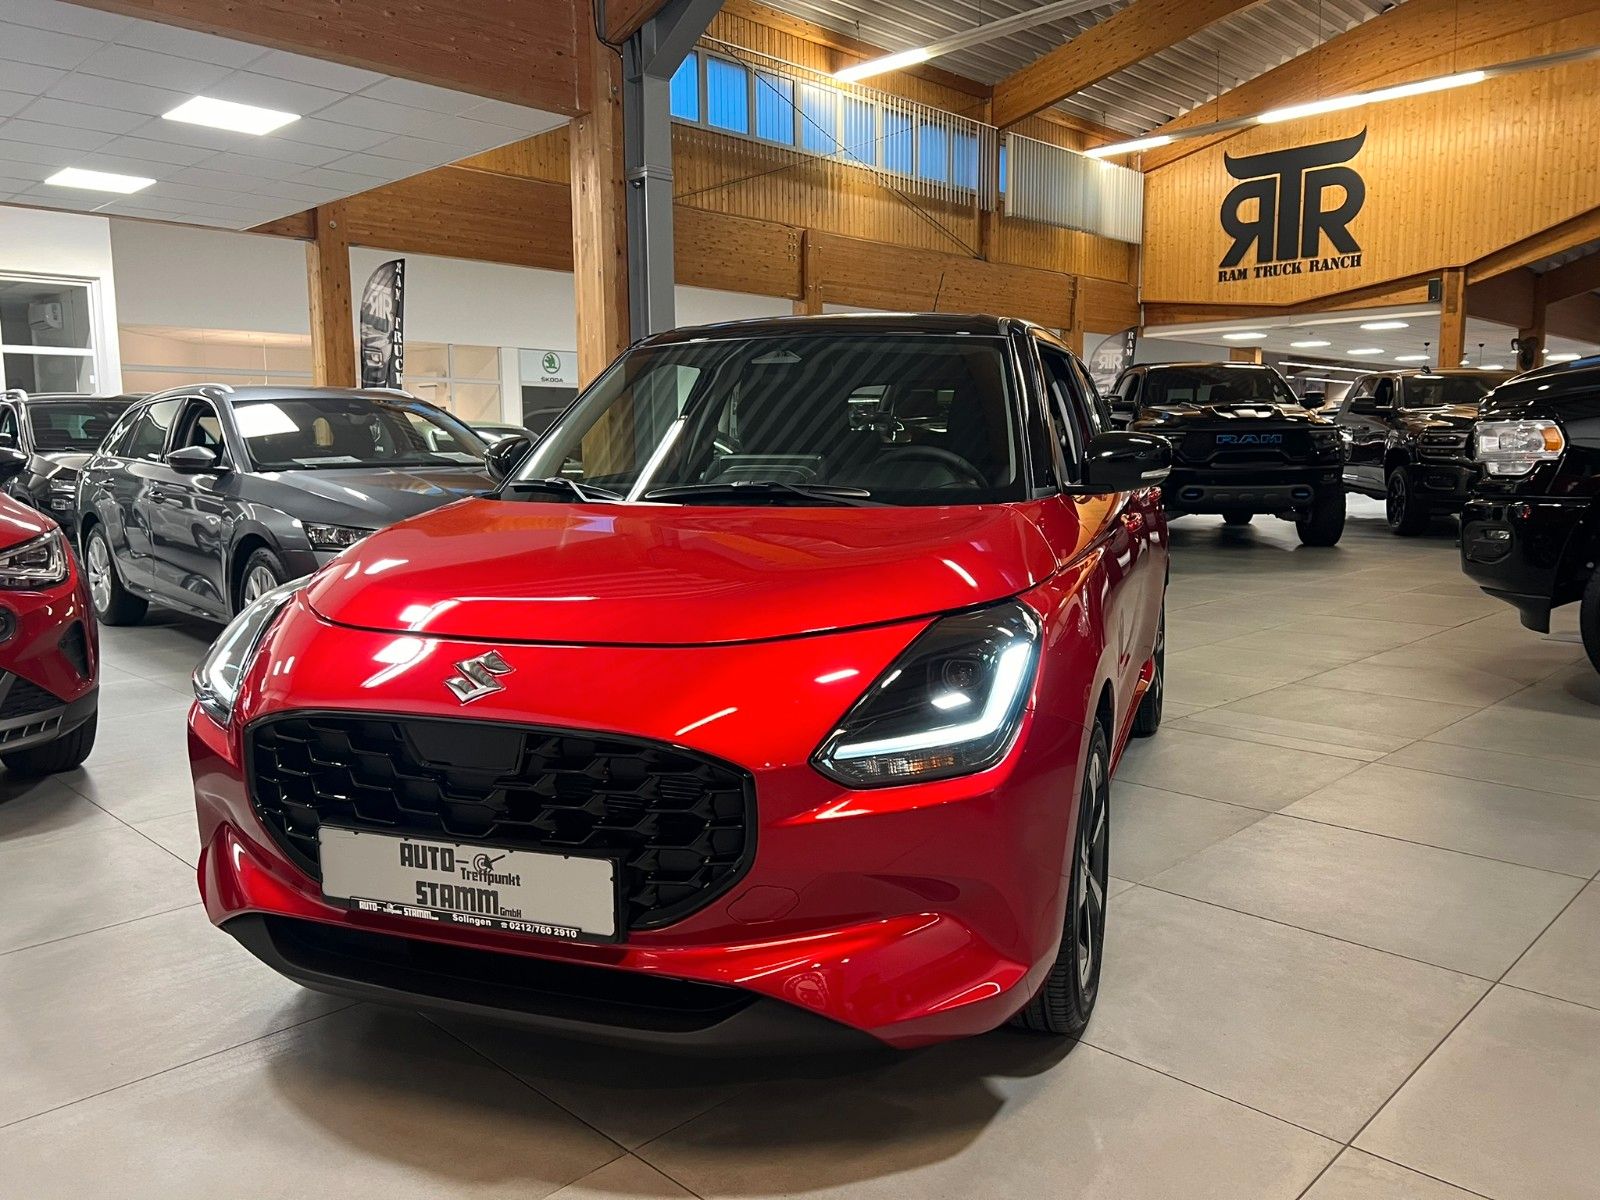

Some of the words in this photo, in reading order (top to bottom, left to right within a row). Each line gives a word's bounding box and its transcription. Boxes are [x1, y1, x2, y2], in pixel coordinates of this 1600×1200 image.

[1218, 268, 1248, 282] RAM
[1254, 262, 1302, 279] TRUCK
[1309, 254, 1362, 272] RANCH
[1126, 331, 1134, 356] RAM
[1216, 434, 1282, 444] RAM
[460, 867, 521, 887] Treffpunkt
[416, 880, 499, 916] STAMM
[500, 906, 522, 918] GmbH
[404, 907, 432, 918] STAMM
[452, 914, 492, 927] Solingen
[509, 921, 552, 935] 0212/760
[553, 927, 577, 938] 2910
